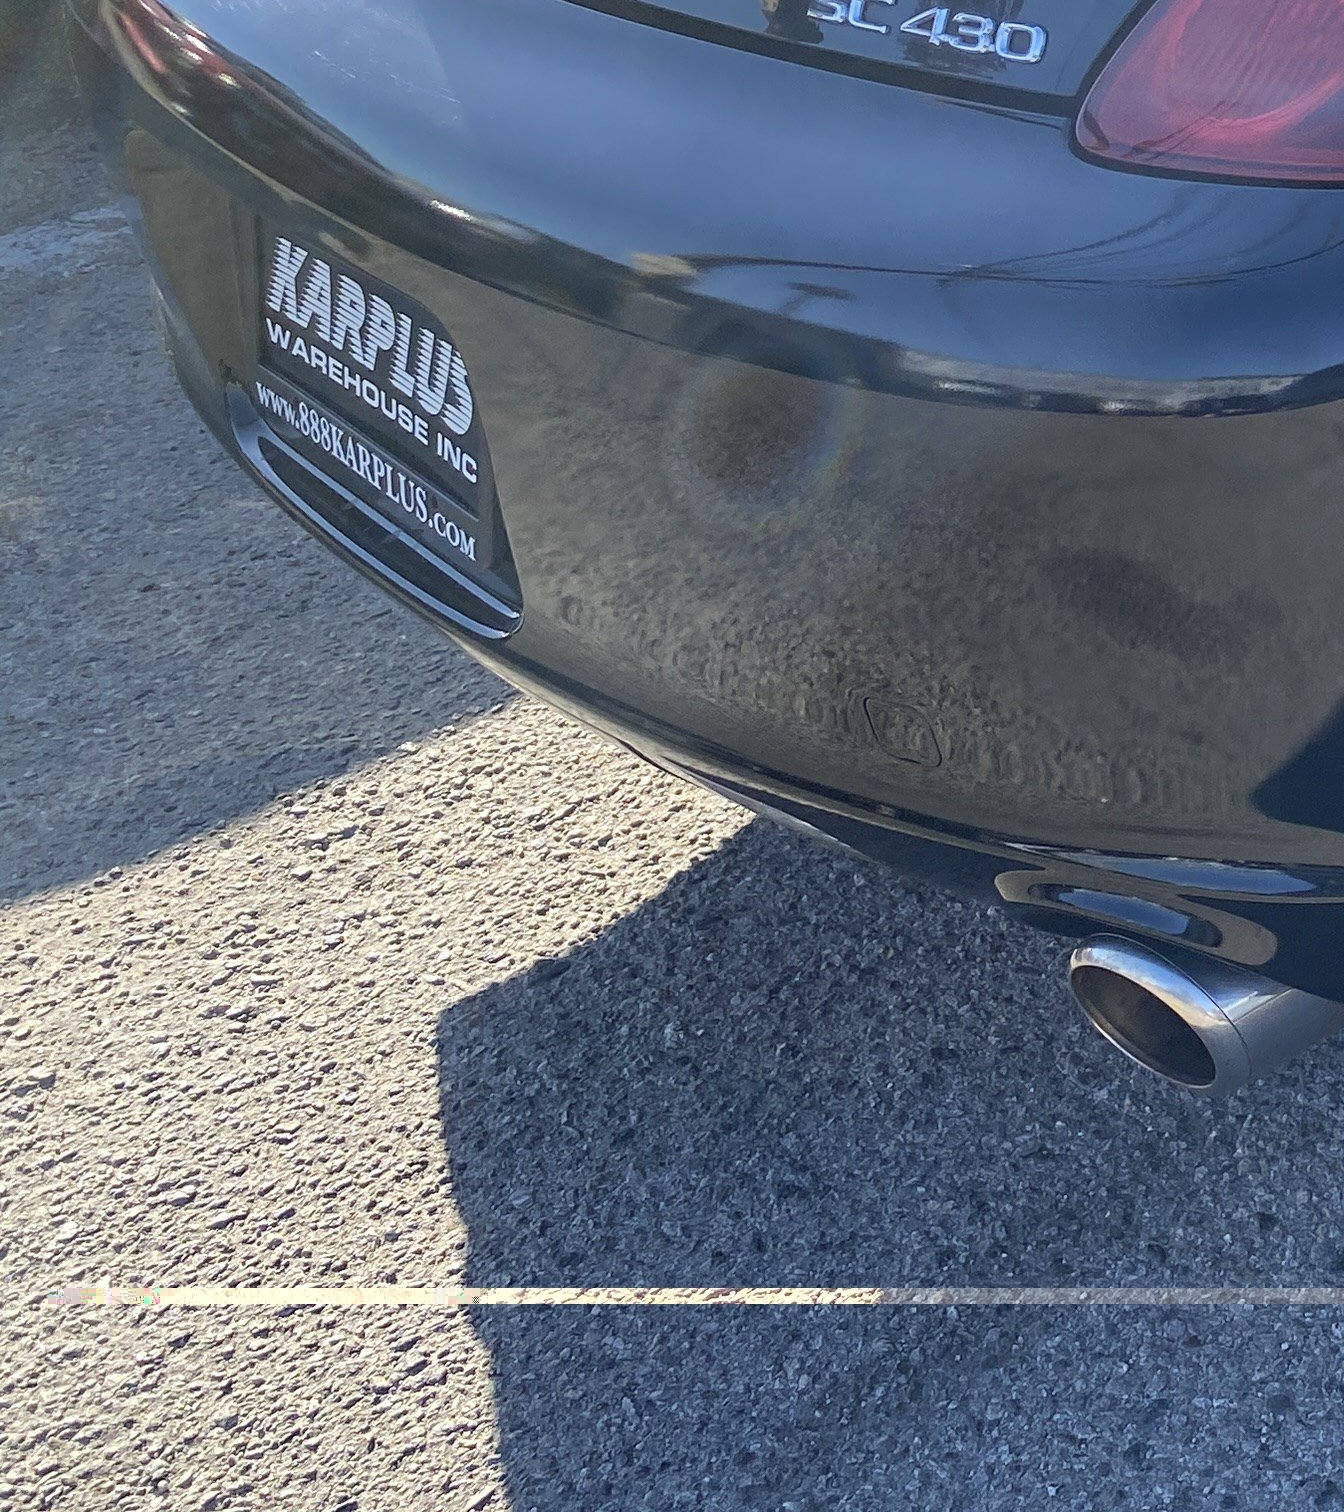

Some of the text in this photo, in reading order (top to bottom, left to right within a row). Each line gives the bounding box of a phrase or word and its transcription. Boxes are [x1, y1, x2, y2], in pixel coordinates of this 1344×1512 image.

[899, 5, 1048, 64] 430
[265, 316, 479, 485] WAREHOUSE INC
[266, 235, 474, 437] KARPLUS
